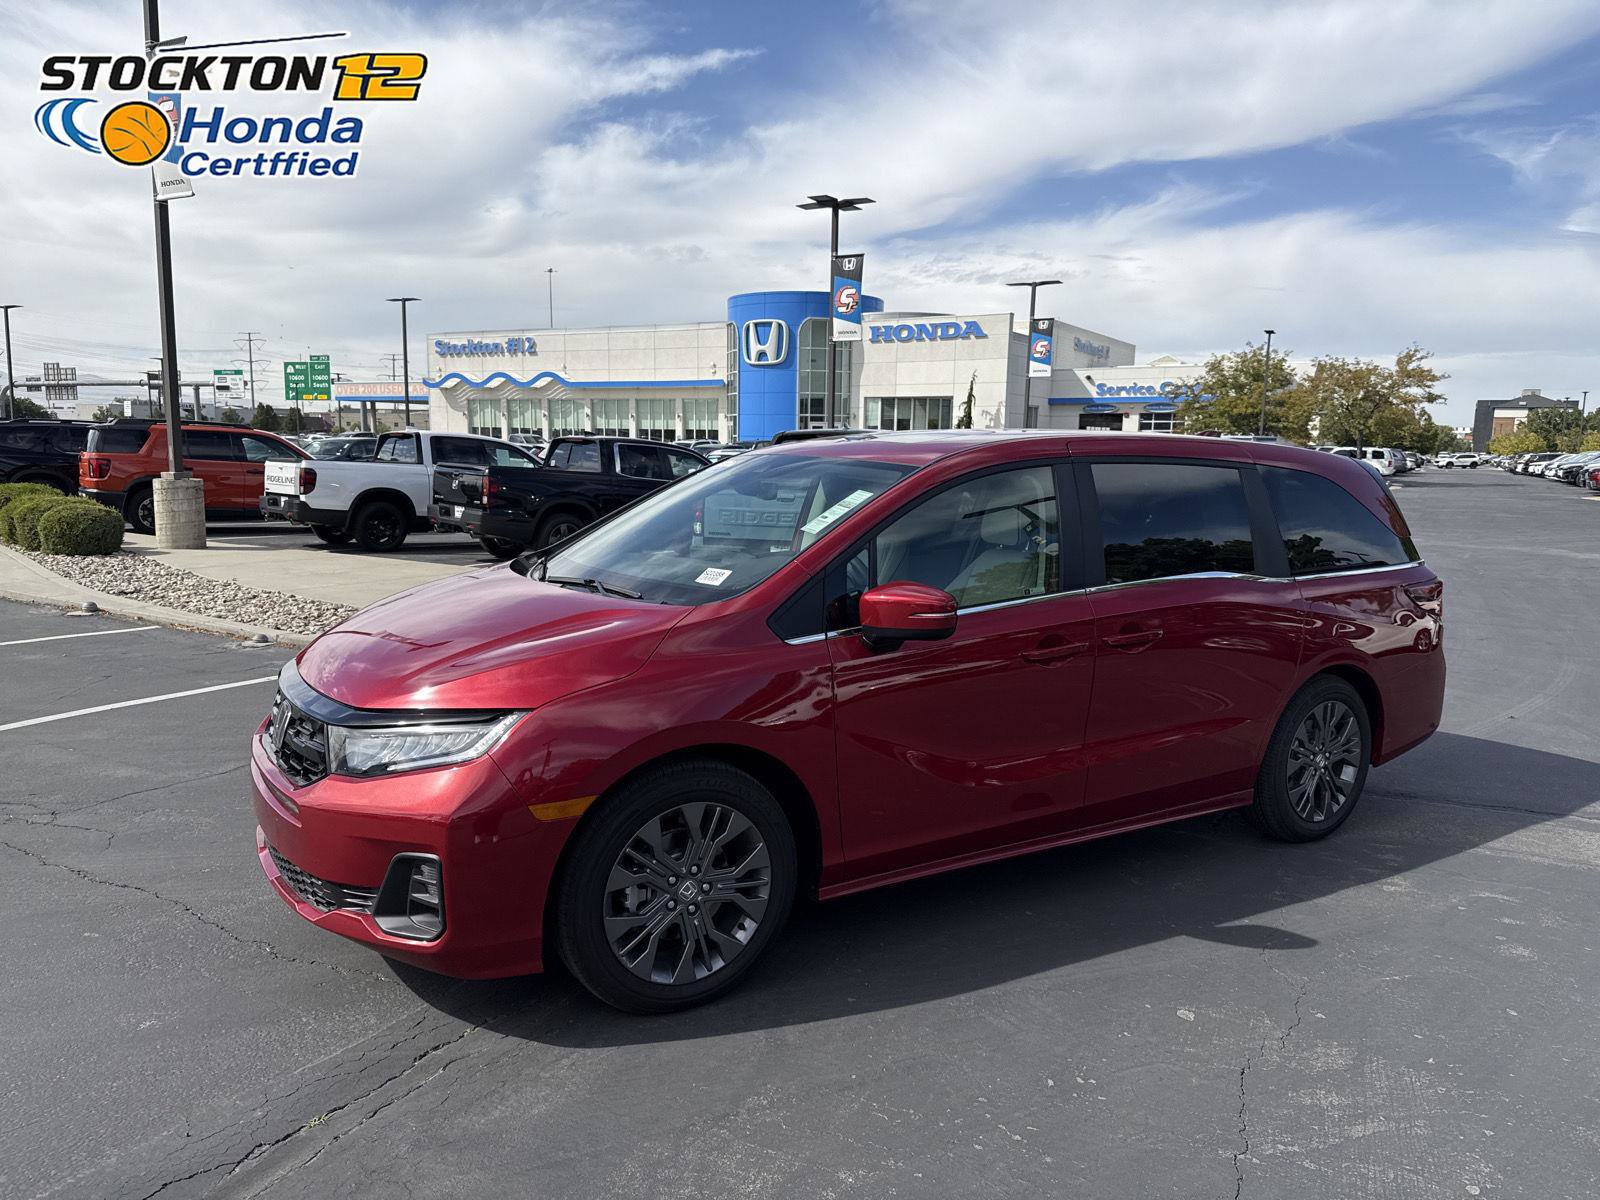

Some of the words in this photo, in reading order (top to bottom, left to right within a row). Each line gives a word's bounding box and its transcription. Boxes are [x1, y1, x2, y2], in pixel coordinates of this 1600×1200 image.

[161, 179, 185, 187] HONDA
[869, 320, 987, 343] HONDA
[434, 338, 502, 356] Stockton
[505, 336, 537, 355] #12
[336, 384, 360, 394] OVER
[361, 384, 378, 394] 200
[380, 383, 403, 394] USED
[1096, 382, 1156, 396] Service
[266, 474, 295, 484] RIDGELINE
[720, 511, 799, 525] RIDGE
